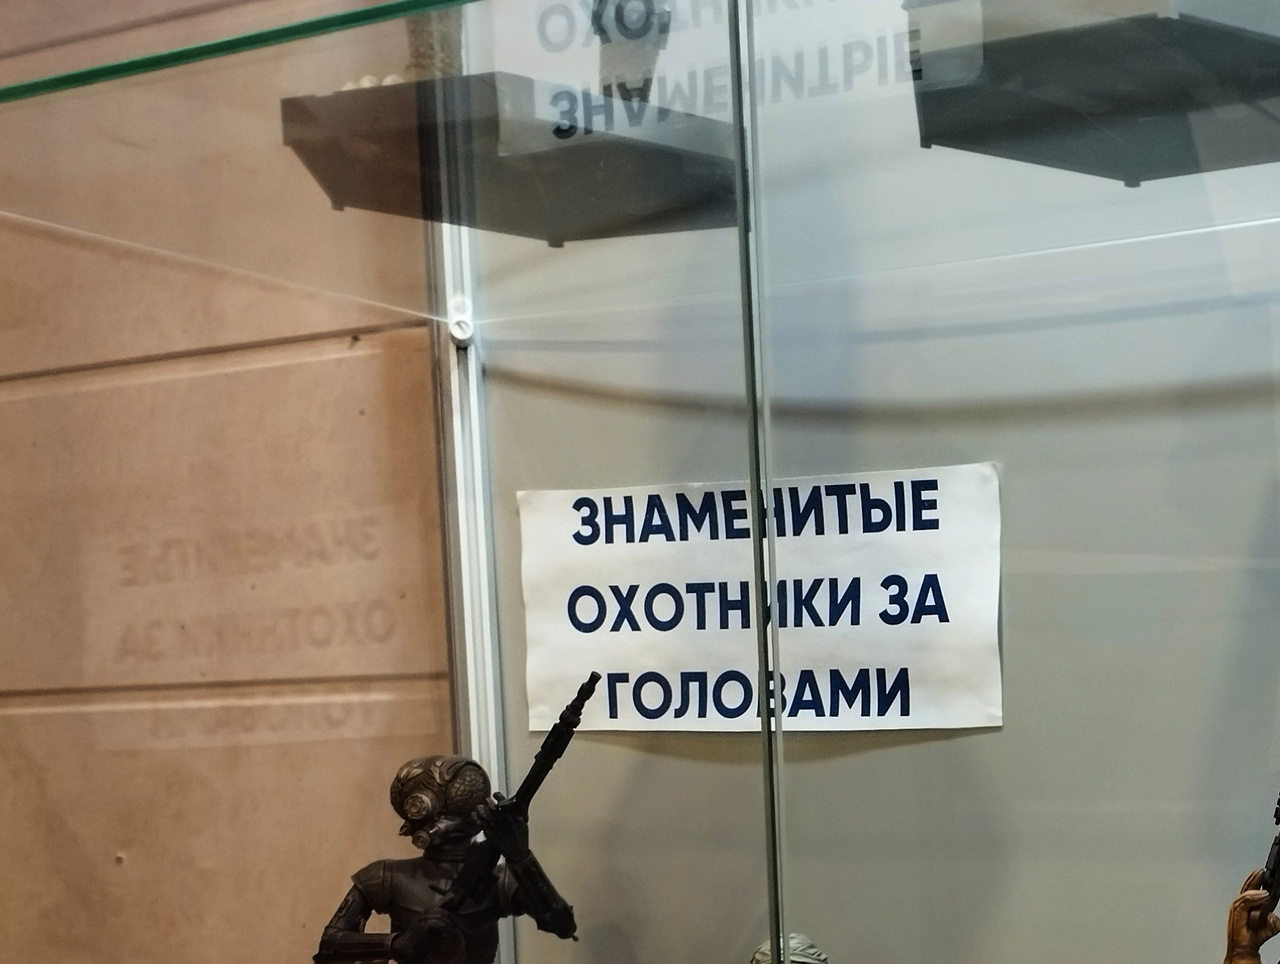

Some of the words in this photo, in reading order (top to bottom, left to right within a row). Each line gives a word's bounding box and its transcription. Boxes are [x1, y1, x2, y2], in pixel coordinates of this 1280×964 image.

[571, 479, 940, 546] ЗНАМЕНИТЫЕ
[567, 577, 861, 633] ОХОТНИКИ
[879, 573, 950, 626] ЗА
[606, 667, 910, 720] ГОЛОВАМИ
